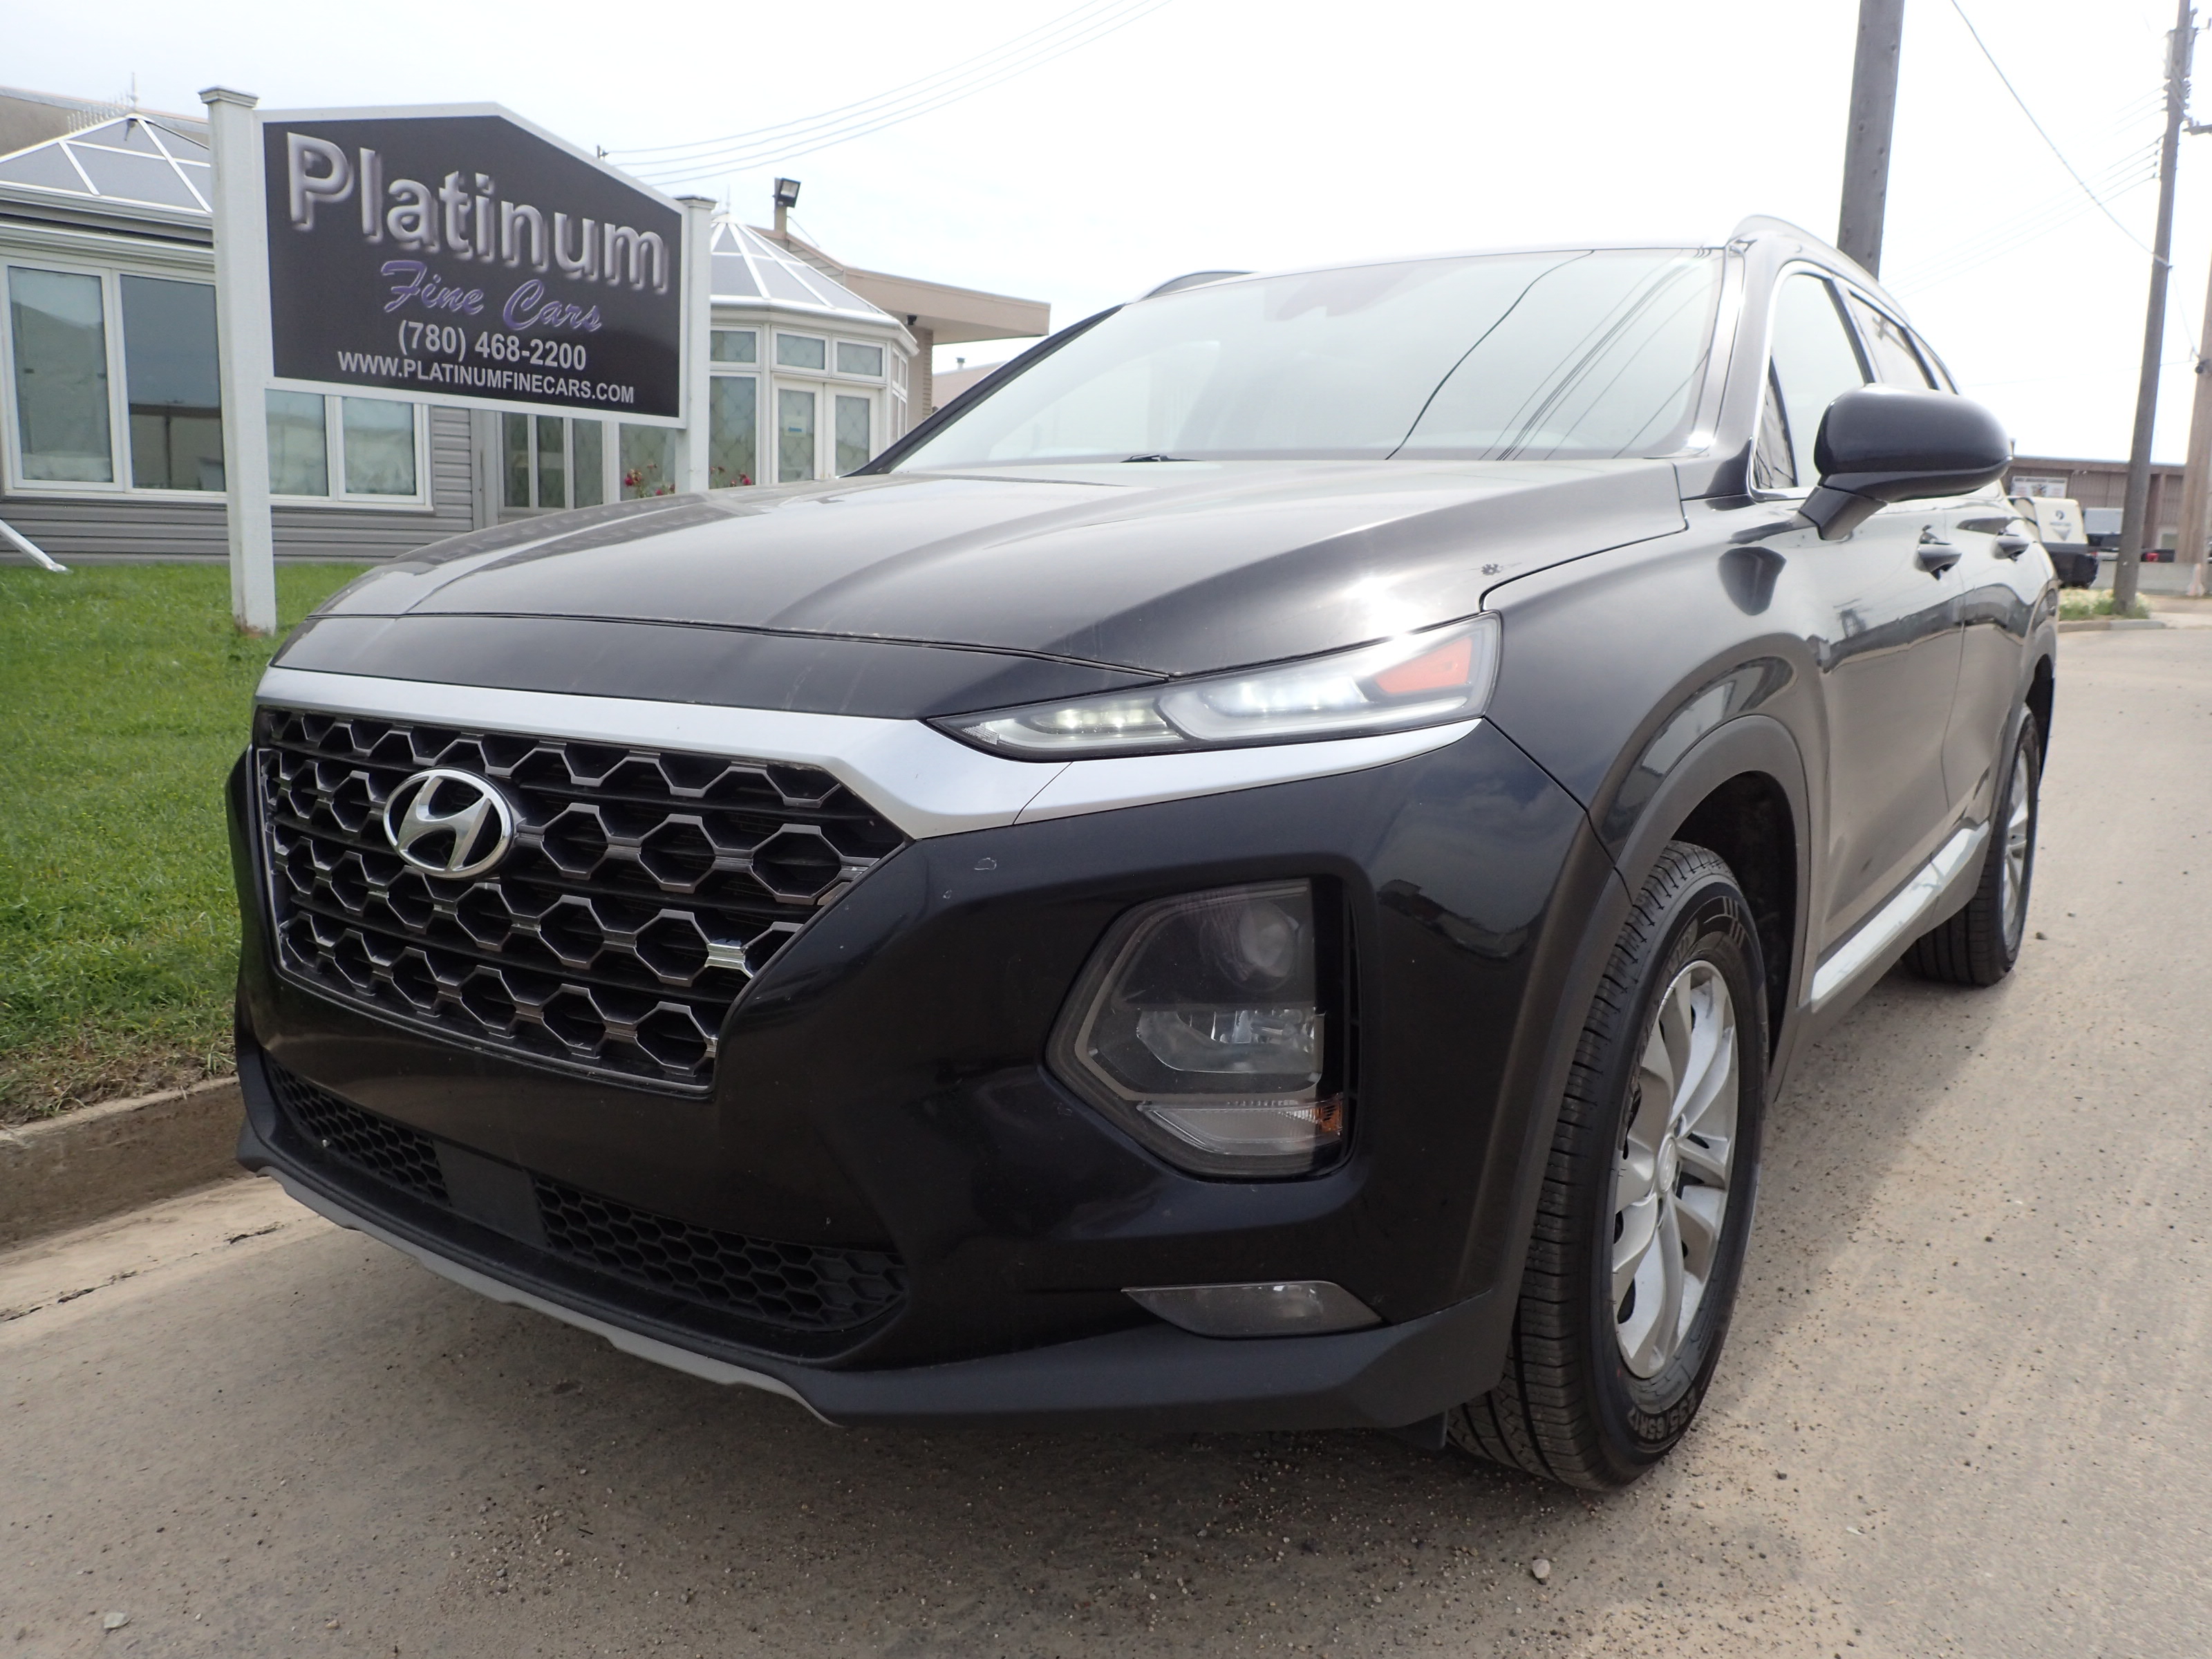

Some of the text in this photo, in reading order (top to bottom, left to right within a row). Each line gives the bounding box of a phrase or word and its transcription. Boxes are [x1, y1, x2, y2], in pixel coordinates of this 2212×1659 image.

[286, 131, 669, 294] Platinum
[380, 260, 603, 333] Fine Cars
[337, 350, 635, 404] WWW.PLATINUMFINECARS.COM
[397, 320, 588, 371] (780) 468-2200
